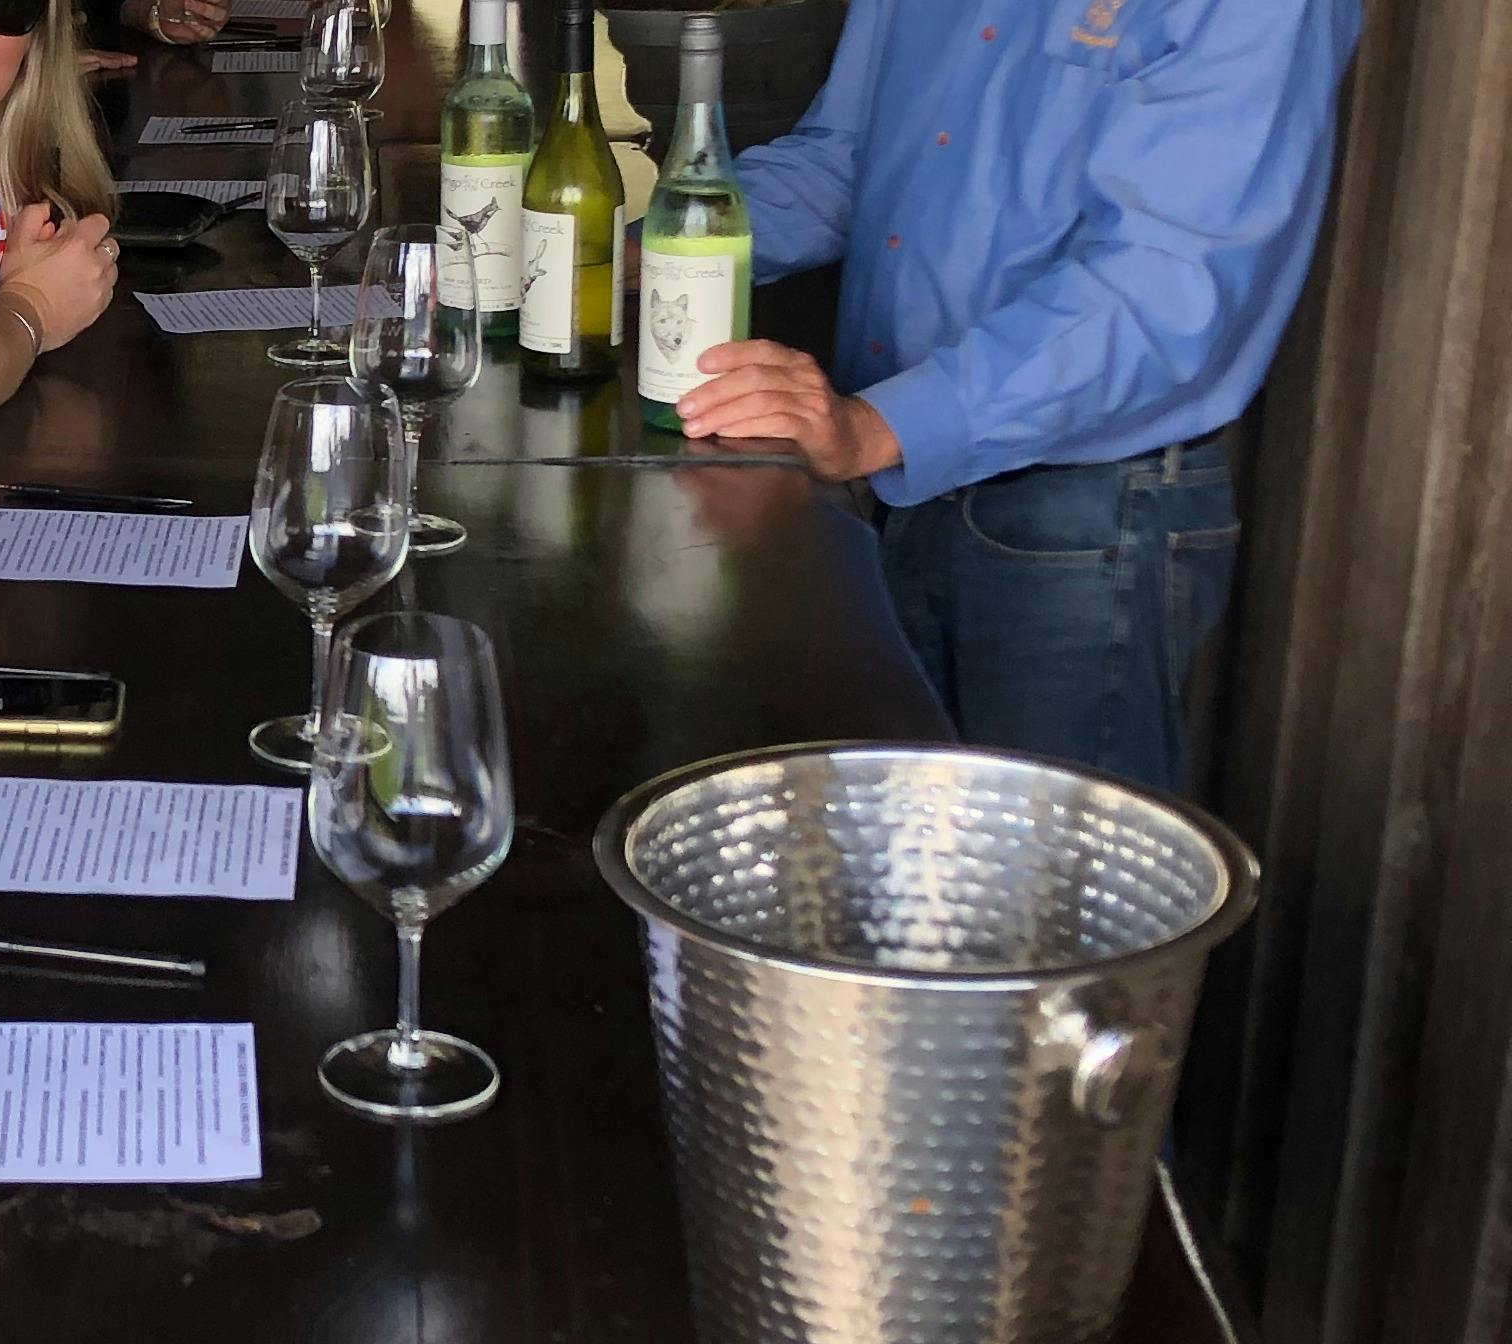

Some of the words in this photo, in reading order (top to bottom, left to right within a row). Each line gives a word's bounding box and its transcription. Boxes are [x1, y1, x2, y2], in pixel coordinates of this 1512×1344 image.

[480, 174, 517, 189] Creek
[530, 220, 564, 235] Creek
[683, 262, 725, 278] Creek
